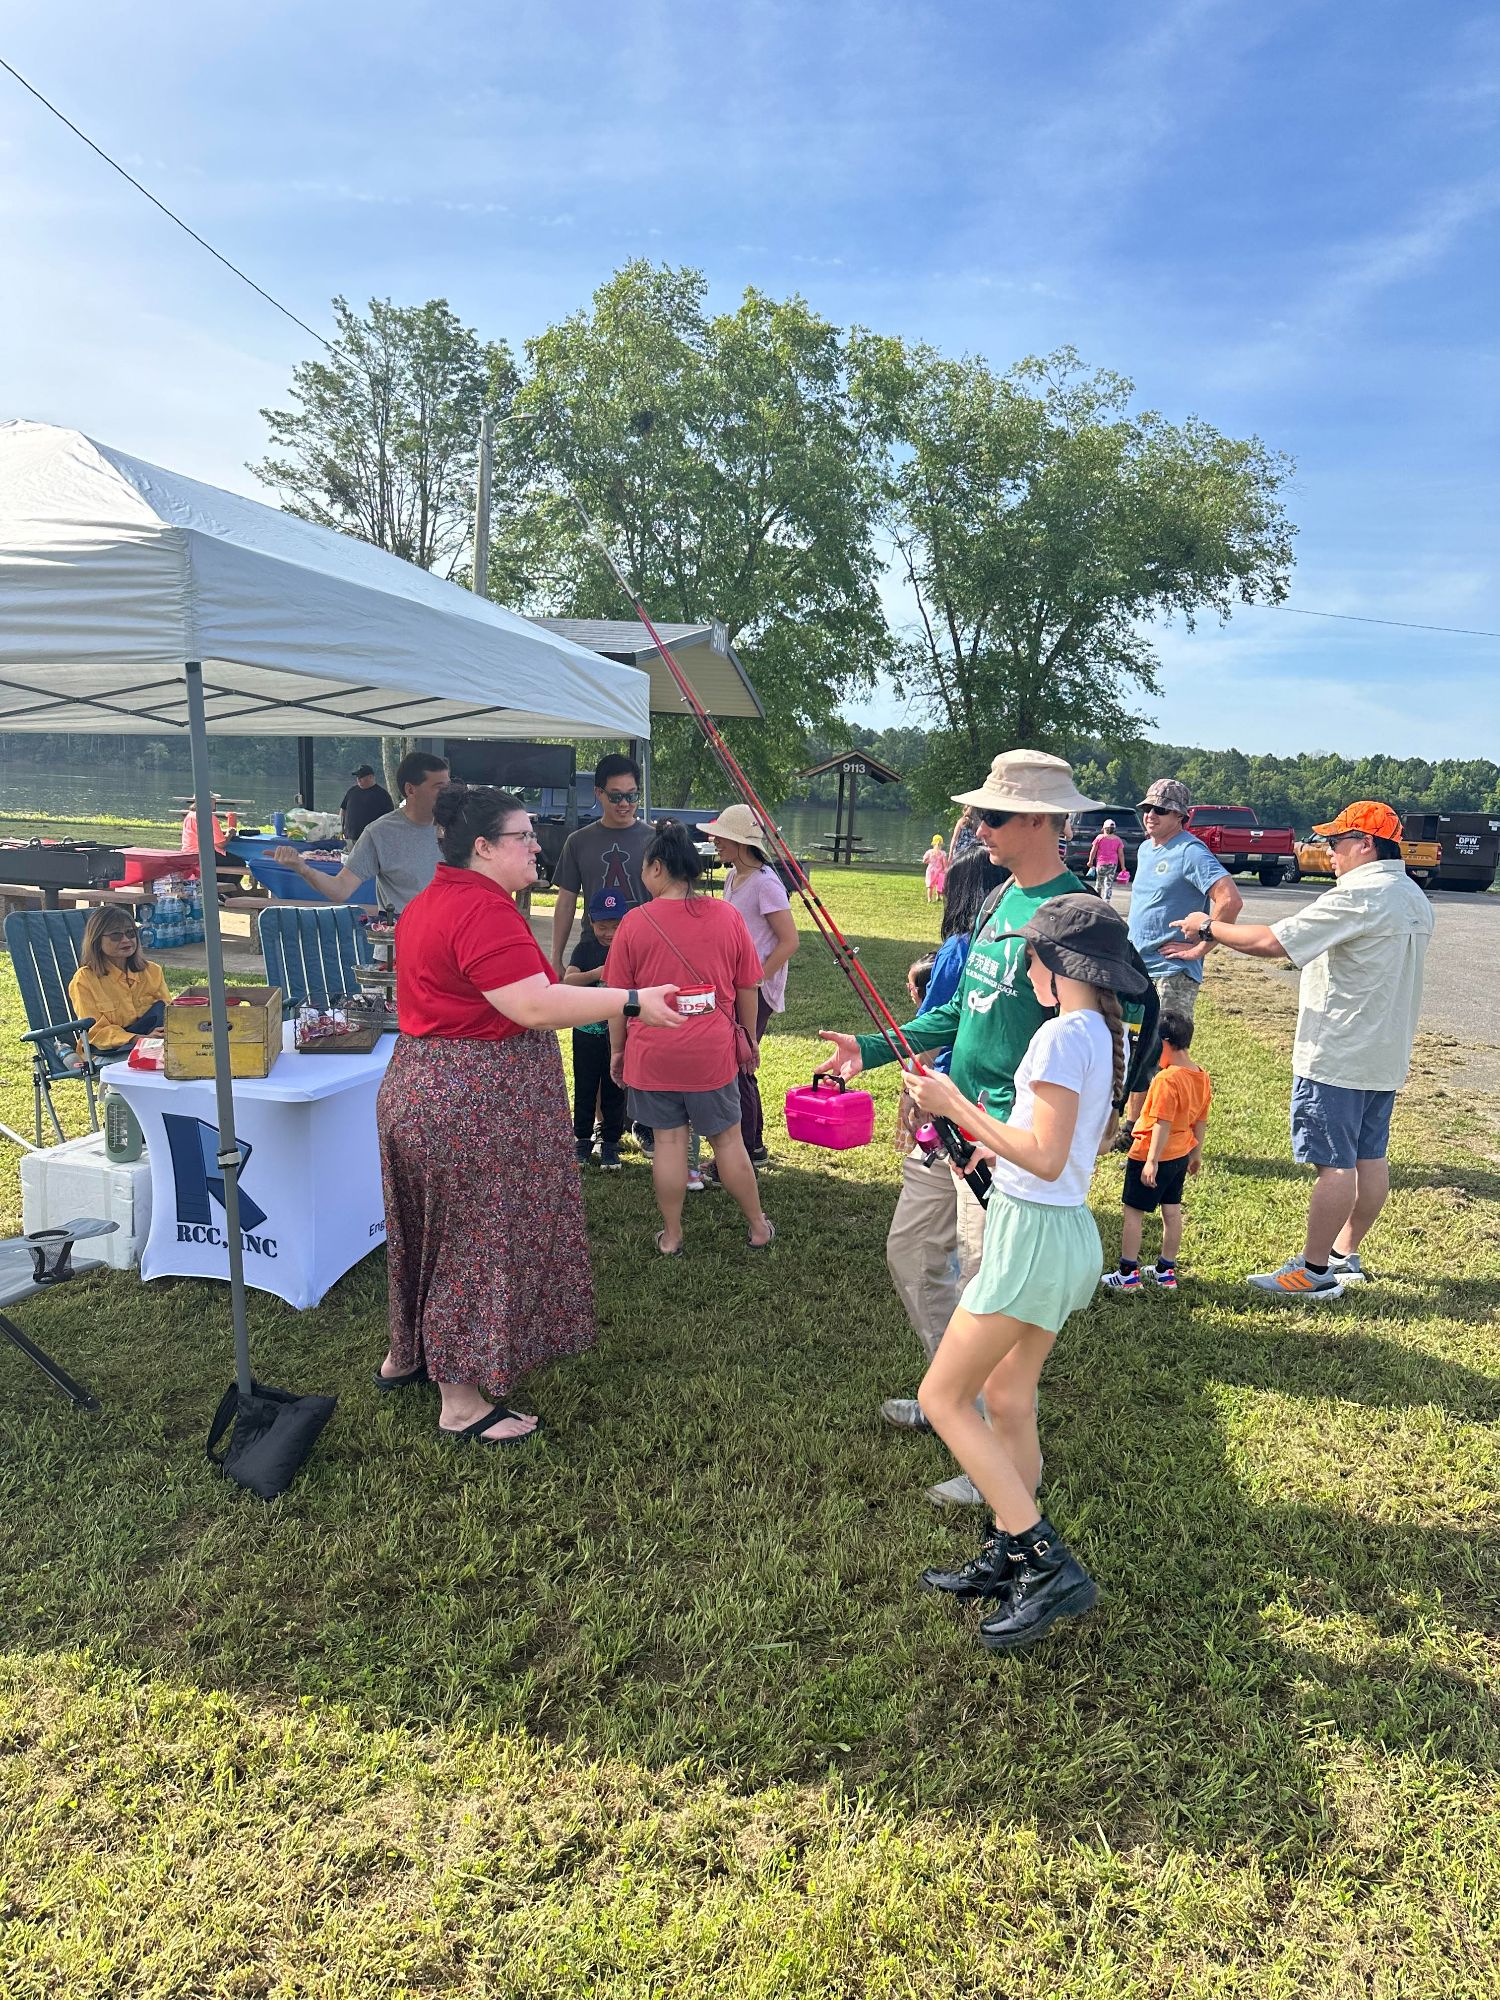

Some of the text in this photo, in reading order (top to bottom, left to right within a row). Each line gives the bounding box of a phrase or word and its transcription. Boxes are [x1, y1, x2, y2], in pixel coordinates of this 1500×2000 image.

[843, 762, 866, 774] 9113
[1458, 837, 1478, 845] DPW
[176, 1223, 229, 1249] RCC,
